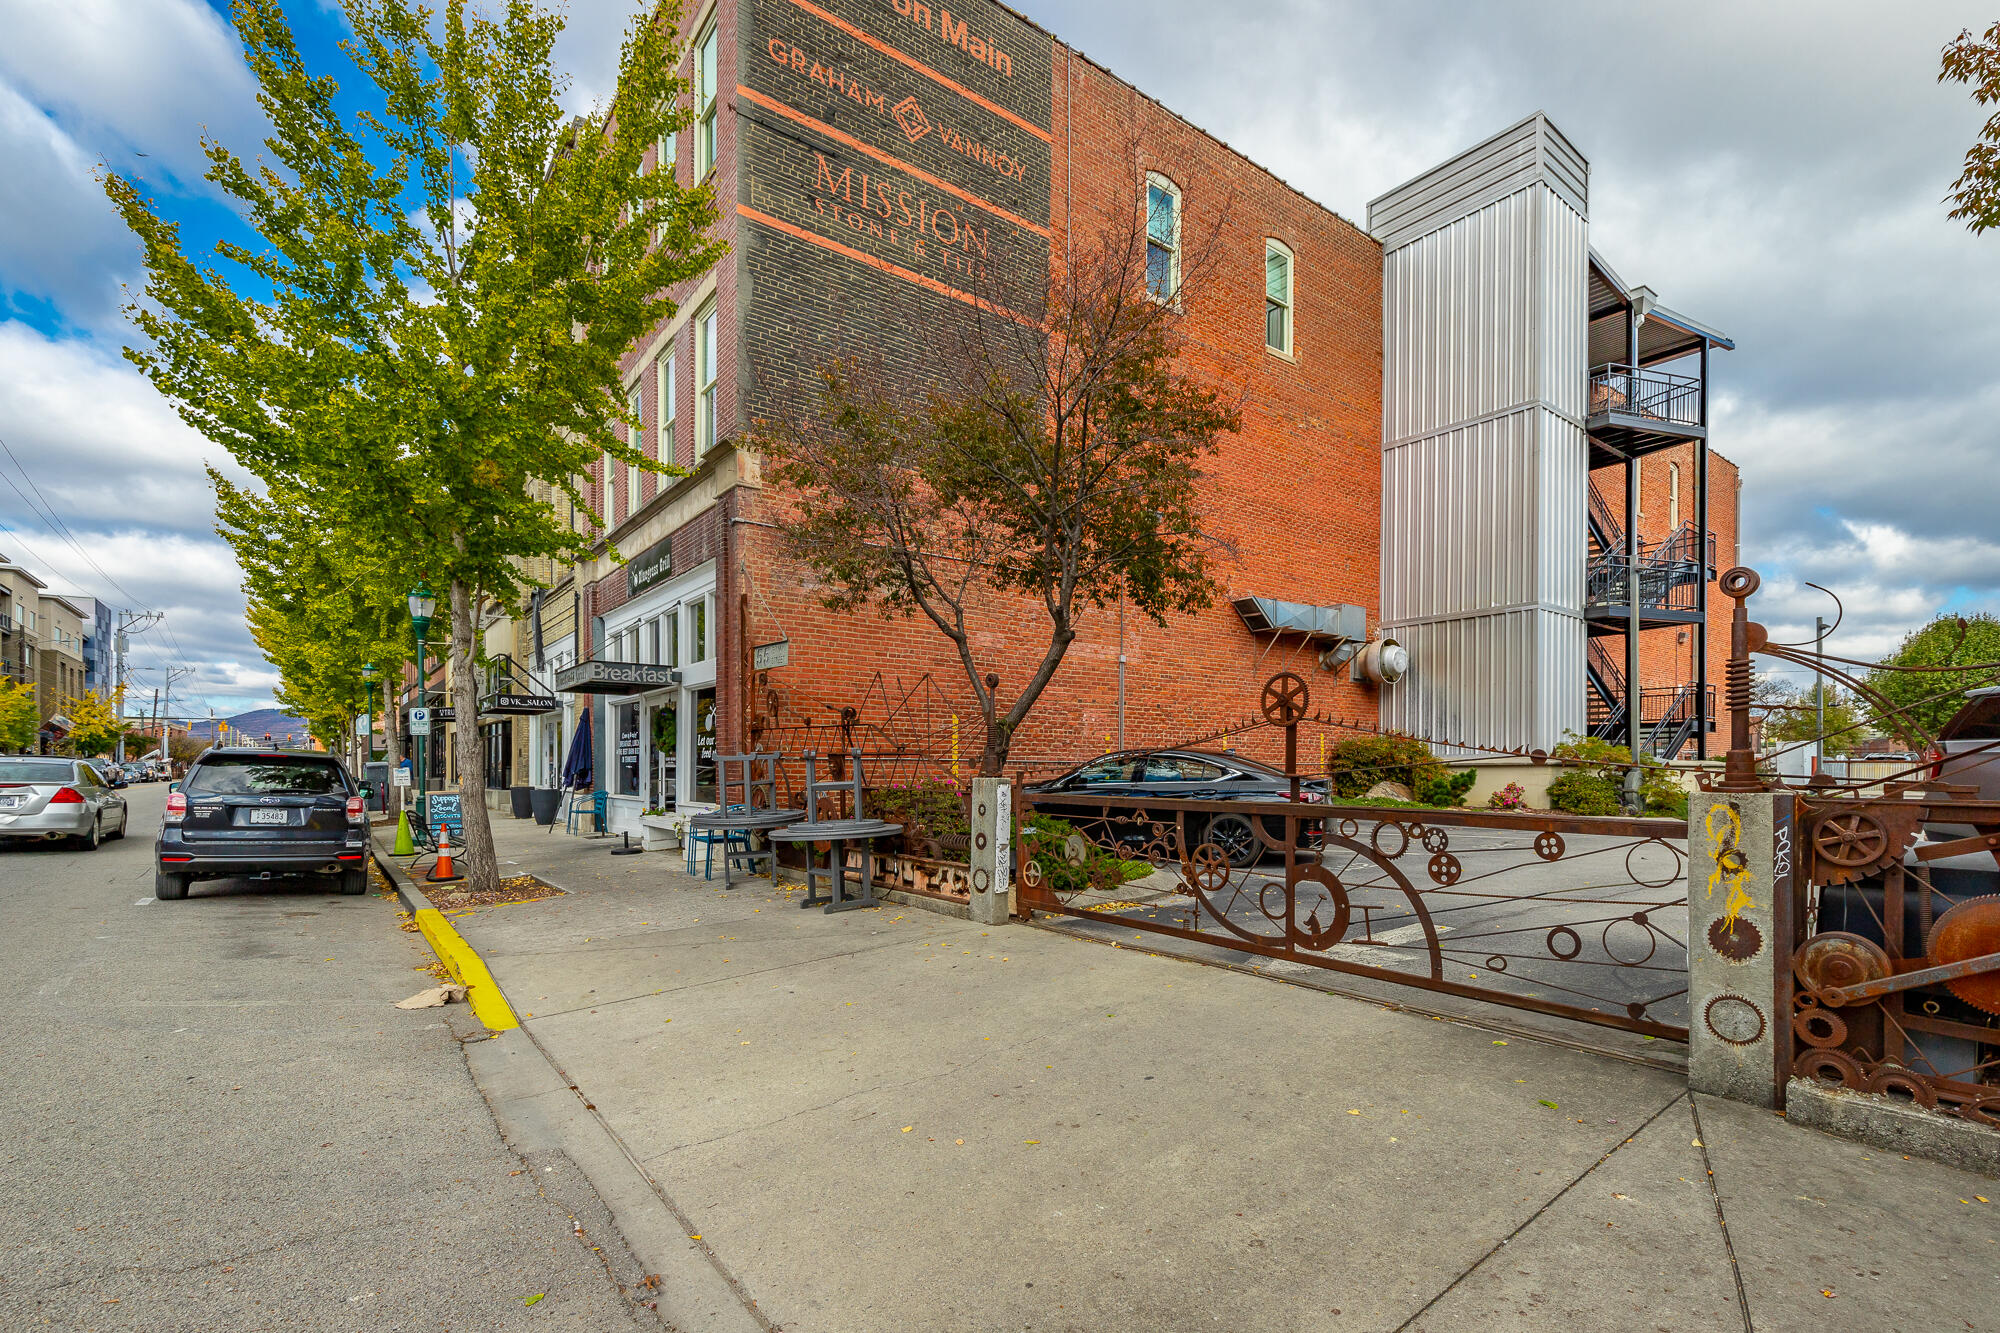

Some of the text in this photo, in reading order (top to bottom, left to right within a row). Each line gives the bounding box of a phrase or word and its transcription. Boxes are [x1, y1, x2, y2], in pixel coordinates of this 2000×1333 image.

[941, 9, 1011, 78] Main
[768, 38, 1026, 182] GRAHAM VANNOY
[814, 153, 988, 259] MISSION
[814, 197, 898, 244] STONE
[914, 239, 926, 256] &
[592, 662, 673, 684] Breakfast
[430, 802, 457, 814] Local
[431, 795, 460, 805] Support
